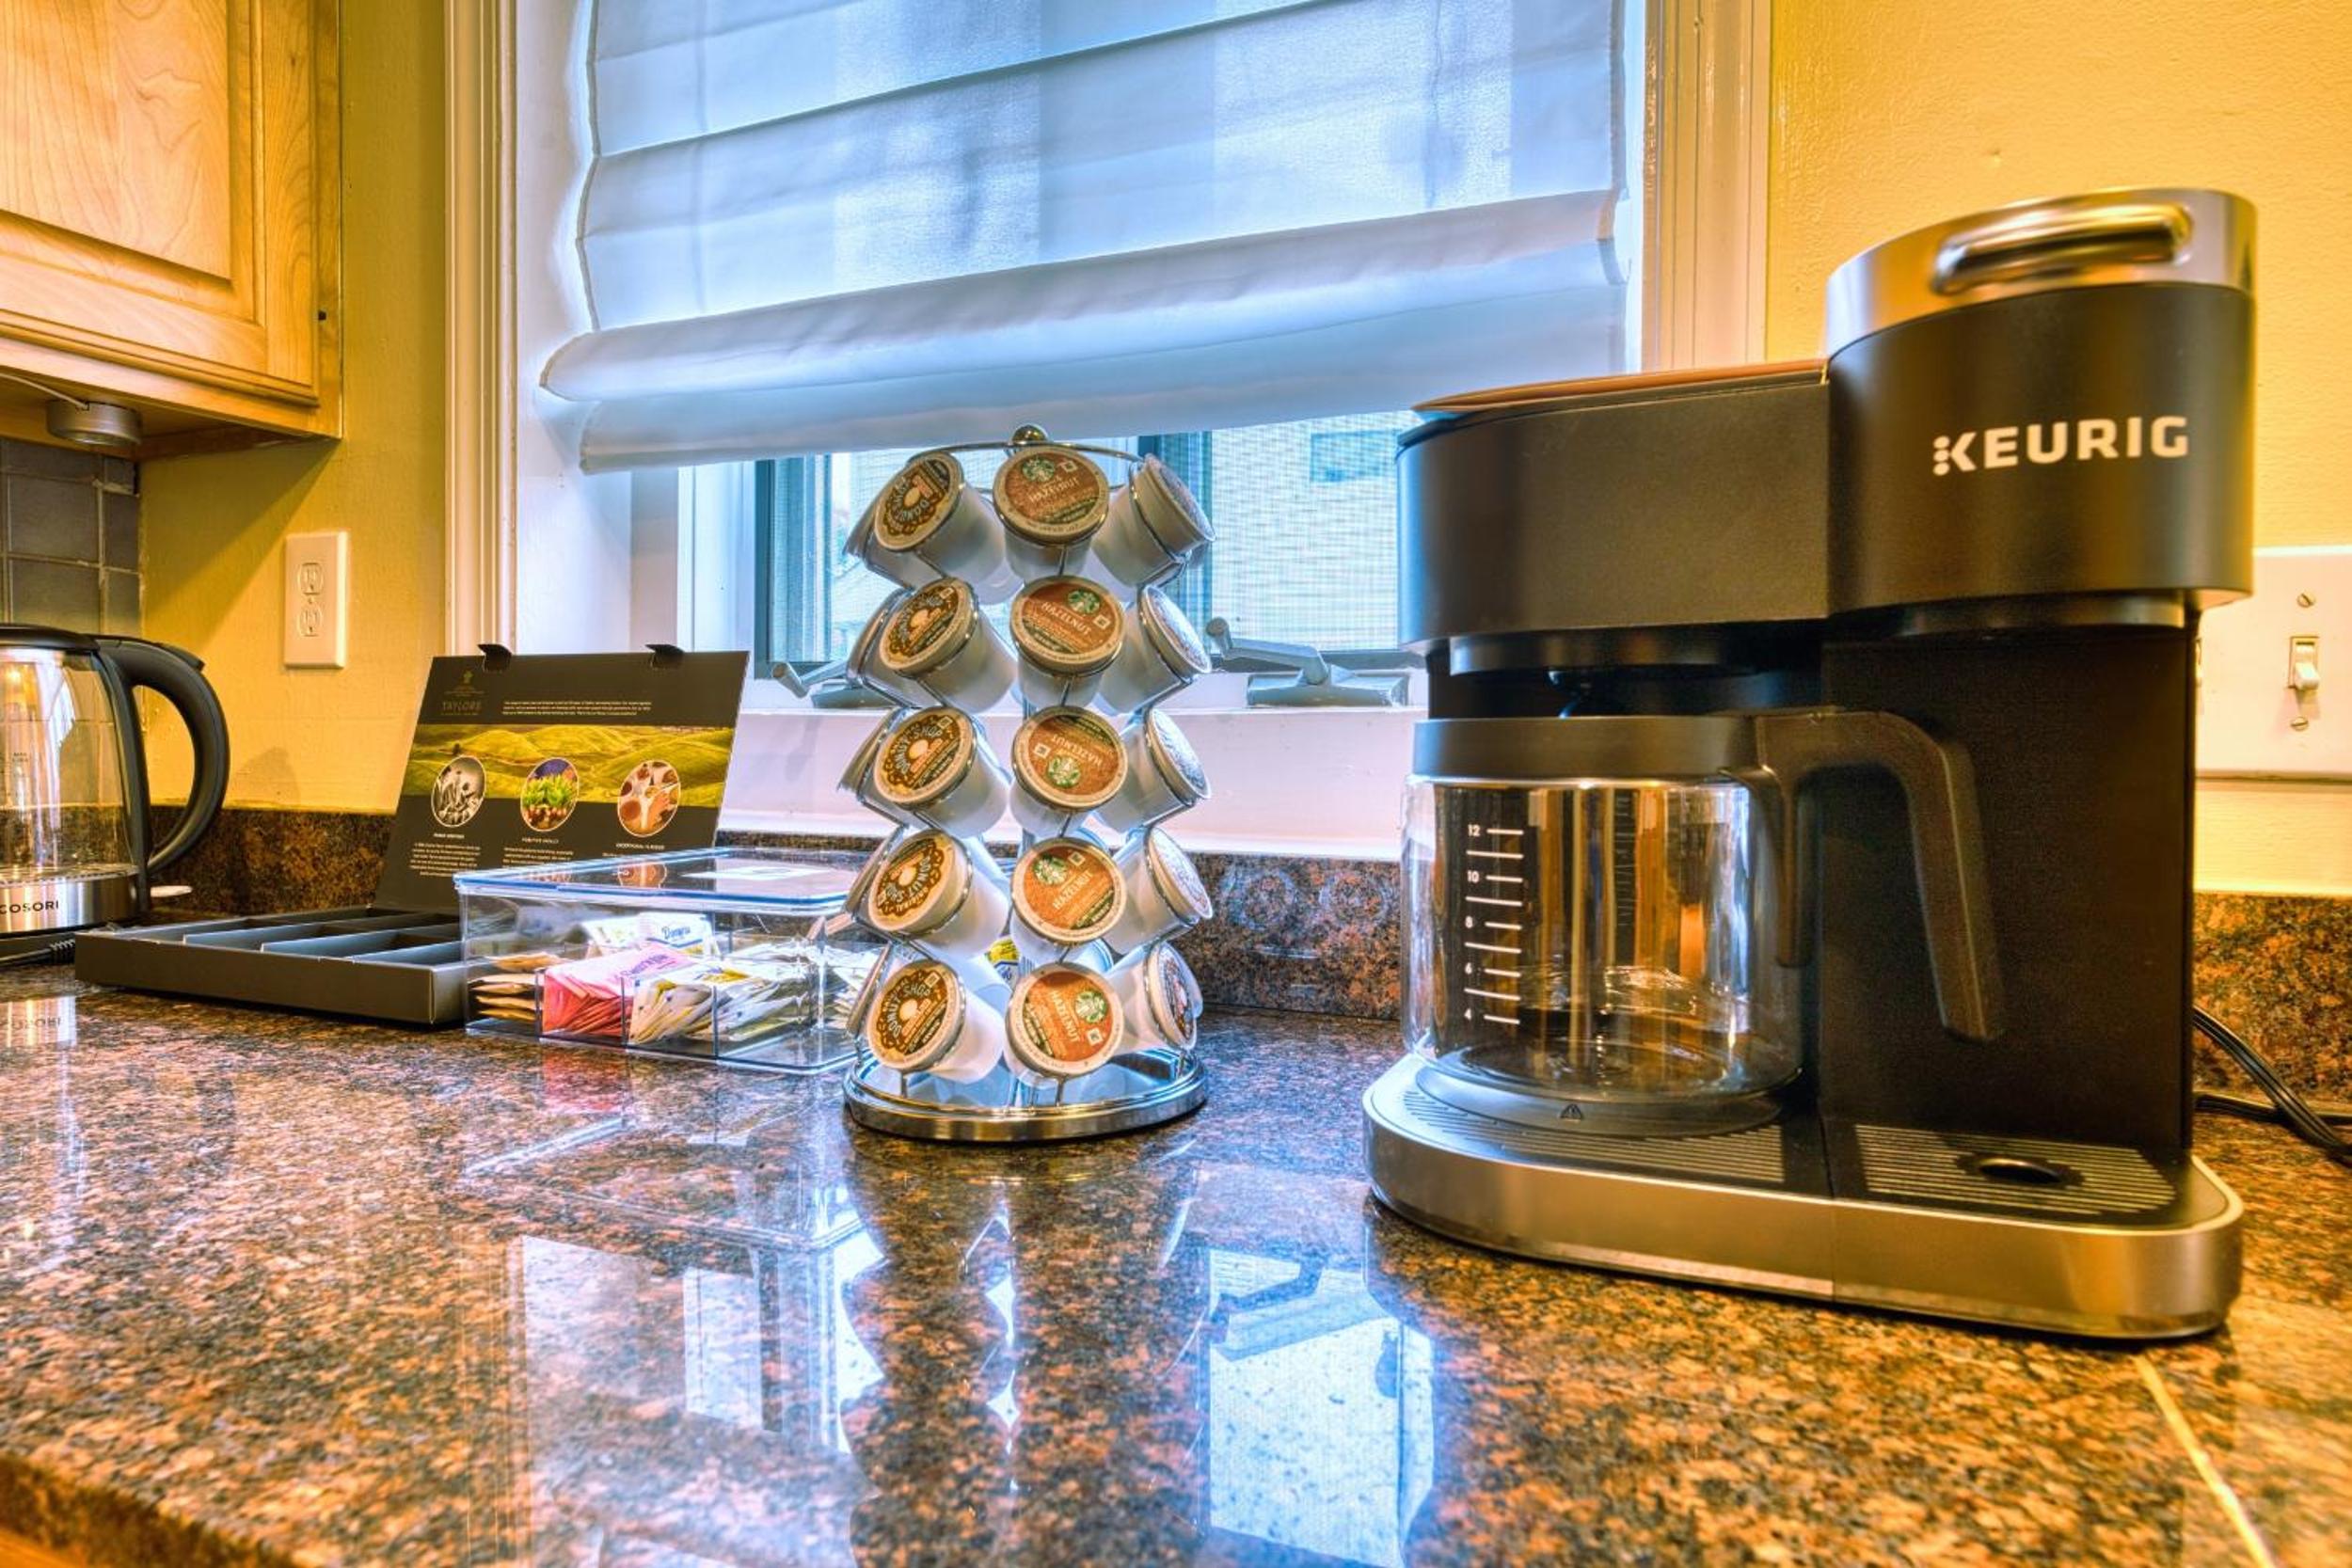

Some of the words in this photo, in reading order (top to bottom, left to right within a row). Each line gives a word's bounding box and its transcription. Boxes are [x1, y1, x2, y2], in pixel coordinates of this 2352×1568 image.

[1932, 416, 2188, 476] KEURIG
[1041, 601, 1092, 636] HAZELNUT
[1052, 734, 1103, 767] HAZELNUT
[1467, 824, 1481, 837] 12
[1466, 869, 1480, 883] 10
[1052, 869, 1093, 910] HAZELNUT
[0, 900, 59, 914] COSORI
[1464, 915, 1473, 928] 8
[1464, 961, 1473, 974] 6
[887, 995, 901, 1037] DONUT
[903, 982, 930, 997] SHOP
[1463, 1007, 1472, 1021] 4
